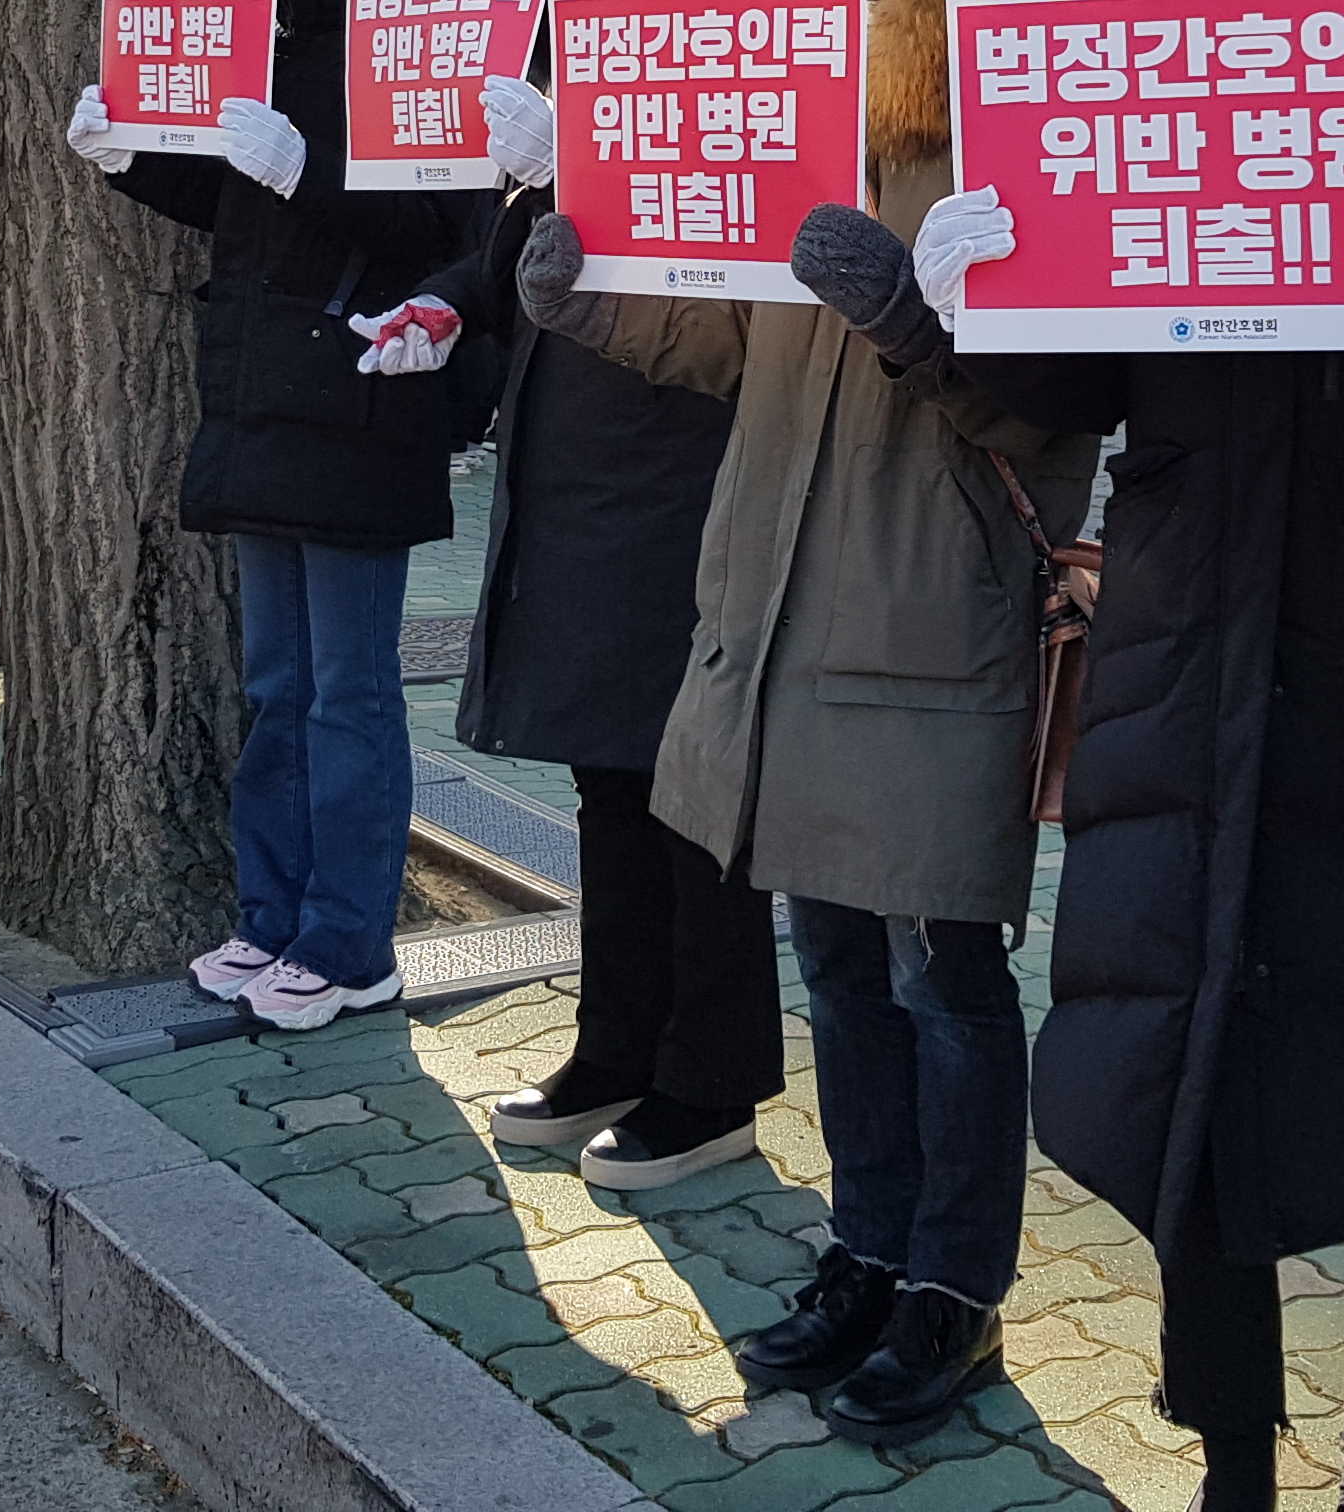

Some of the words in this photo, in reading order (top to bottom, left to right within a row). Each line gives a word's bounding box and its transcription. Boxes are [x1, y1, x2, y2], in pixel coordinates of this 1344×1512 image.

[117, 8, 174, 56] 위반
[181, 6, 233, 58] 병원
[370, 27, 425, 83] 위반
[430, 20, 493, 77] 병원
[564, 6, 848, 85] 법정간호인력
[138, 64, 211, 117] 퇴출!!
[391, 90, 463, 148] 퇴출!!
[591, 92, 681, 162] 위반
[698, 91, 797, 162] 병원
[1039, 112, 1206, 196] 위반
[630, 172, 757, 245] 퇴출!!
[1110, 201, 1333, 289] 퇴출!!
[1198, 319, 1278, 333] 대한간호협회
